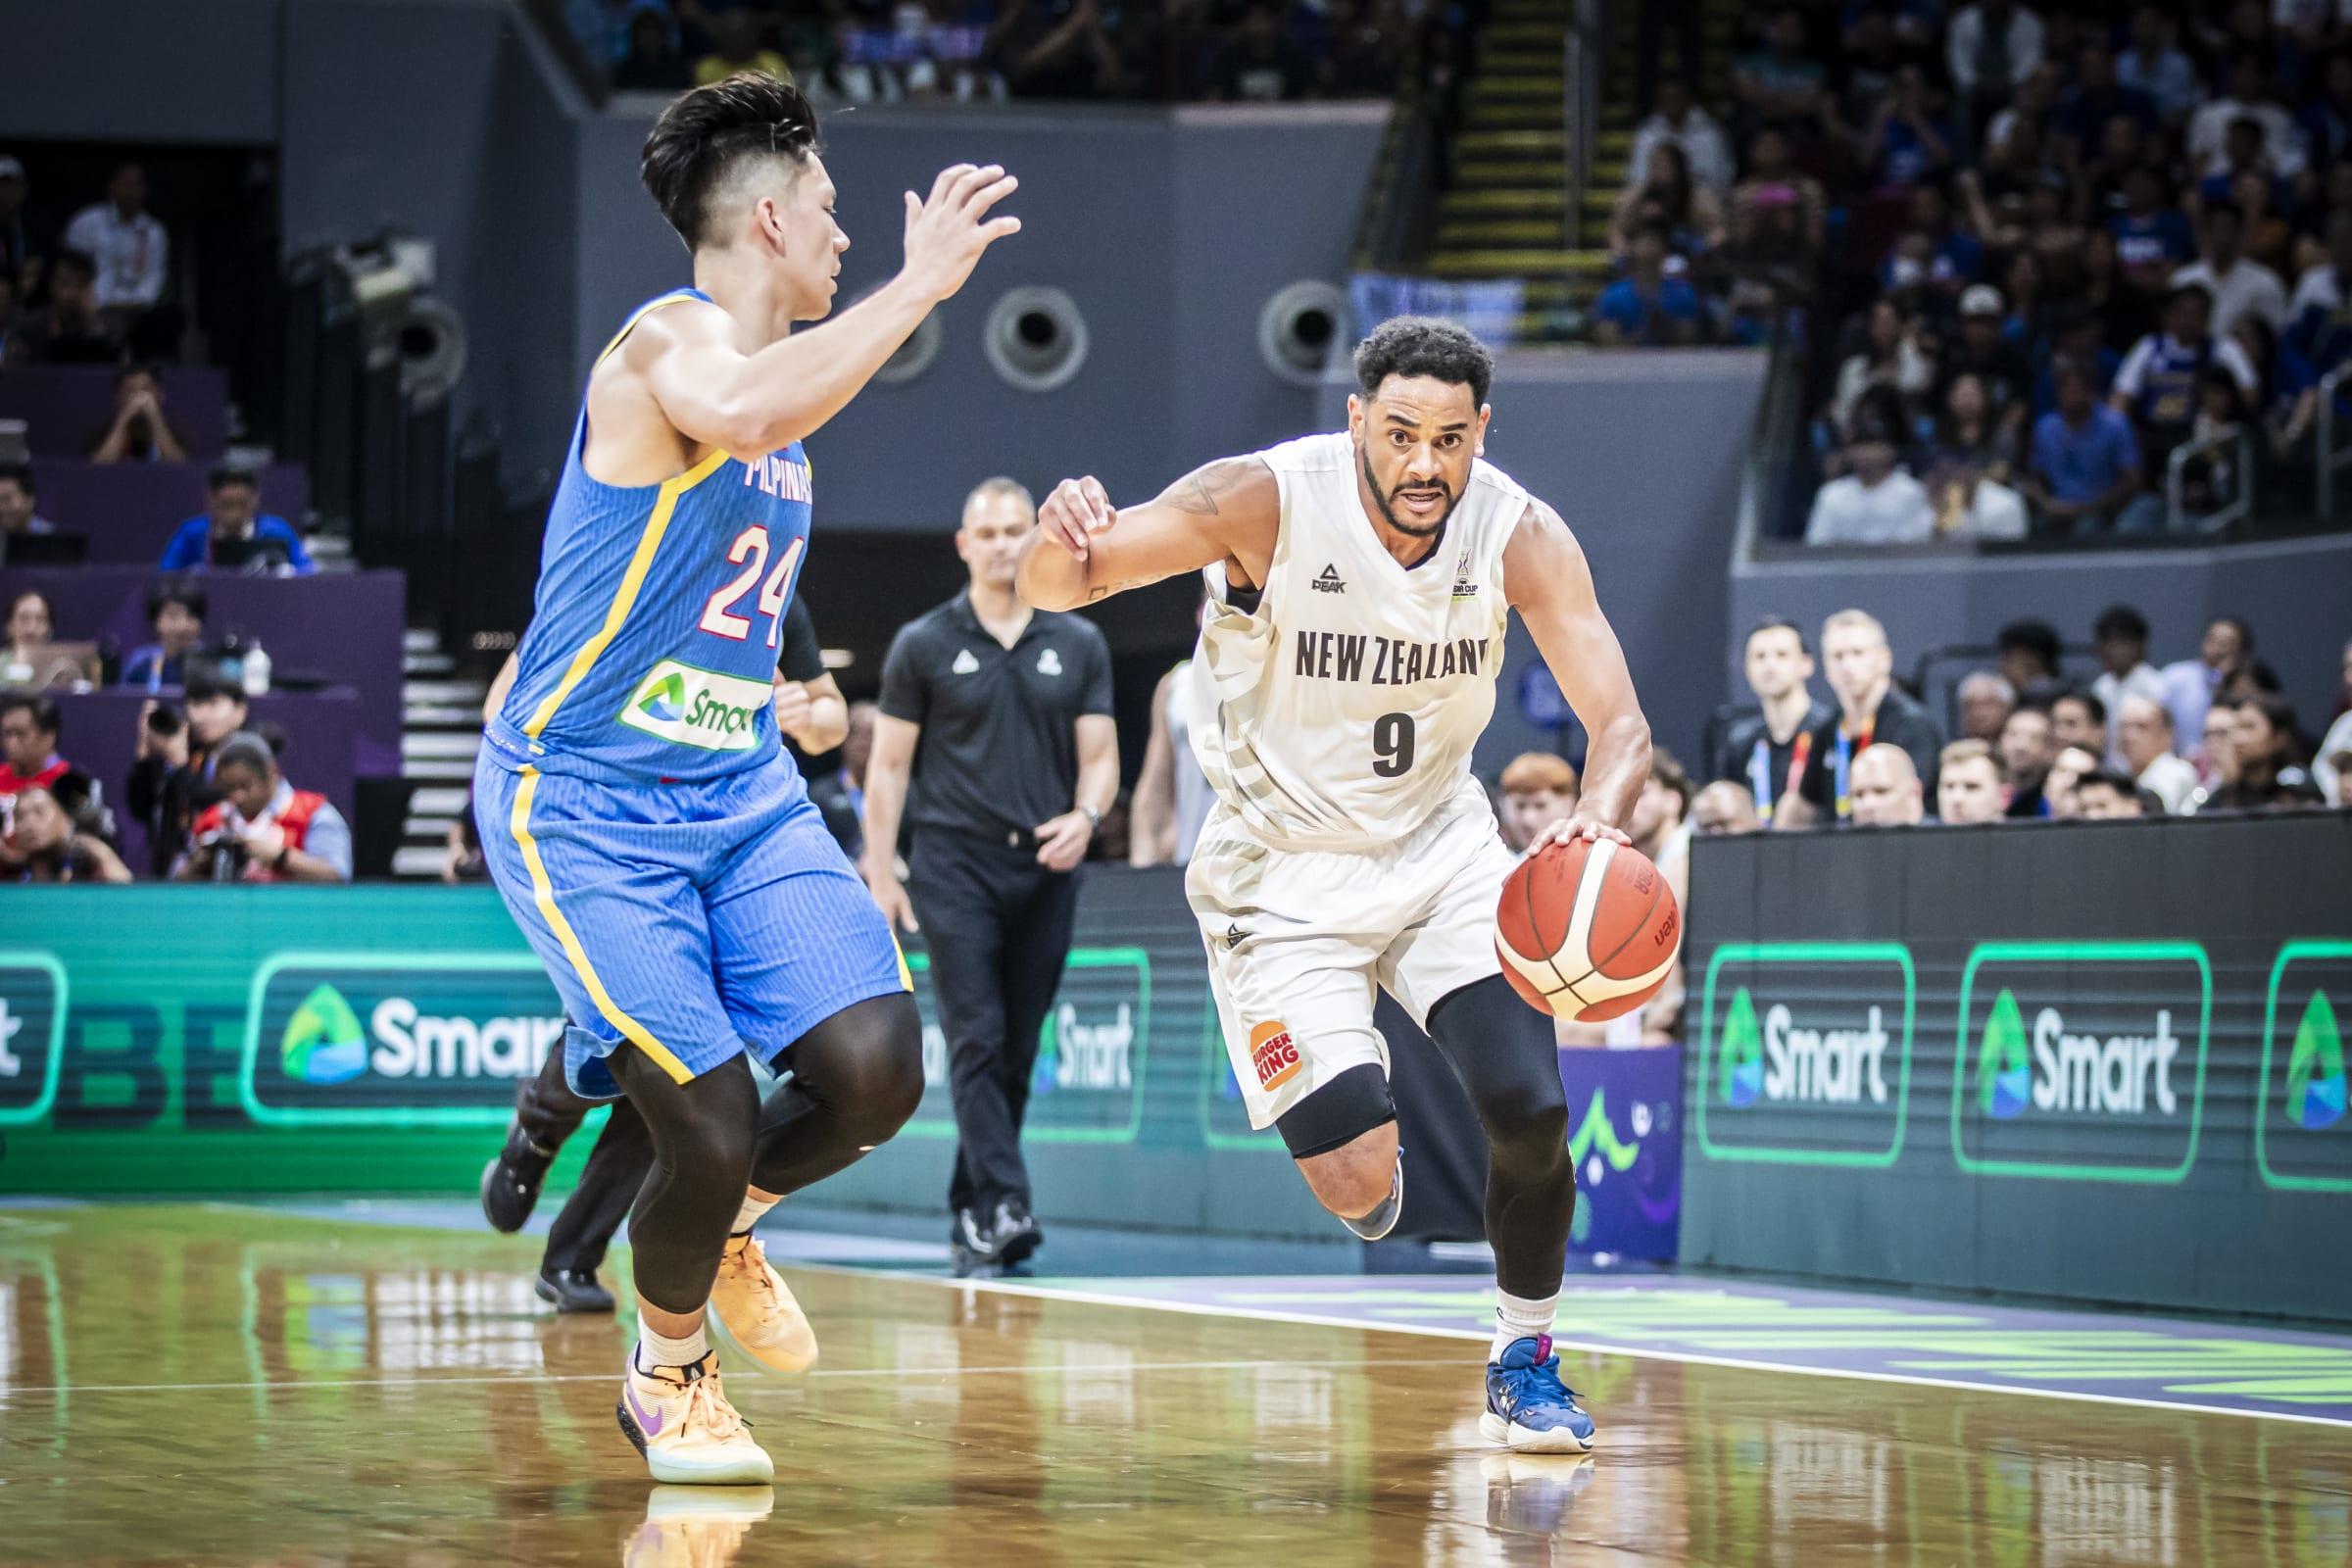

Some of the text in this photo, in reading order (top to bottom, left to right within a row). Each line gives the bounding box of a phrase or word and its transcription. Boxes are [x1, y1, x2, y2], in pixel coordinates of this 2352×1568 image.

[698, 524, 805, 649] 24
[1311, 579, 1348, 594] PEAK
[1464, 584, 1479, 593] CUP
[1296, 630, 1367, 682] NEW
[685, 688, 751, 735] Sma
[1372, 711, 1416, 778] 9
[371, 997, 567, 1078] Smar
[1055, 1002, 1134, 1089] Smart
[1252, 1032, 1292, 1066] BURGER
[1256, 1045, 1299, 1085] KING
[1765, 1004, 1888, 1103] Smart
[2033, 1007, 2179, 1114] Smart
